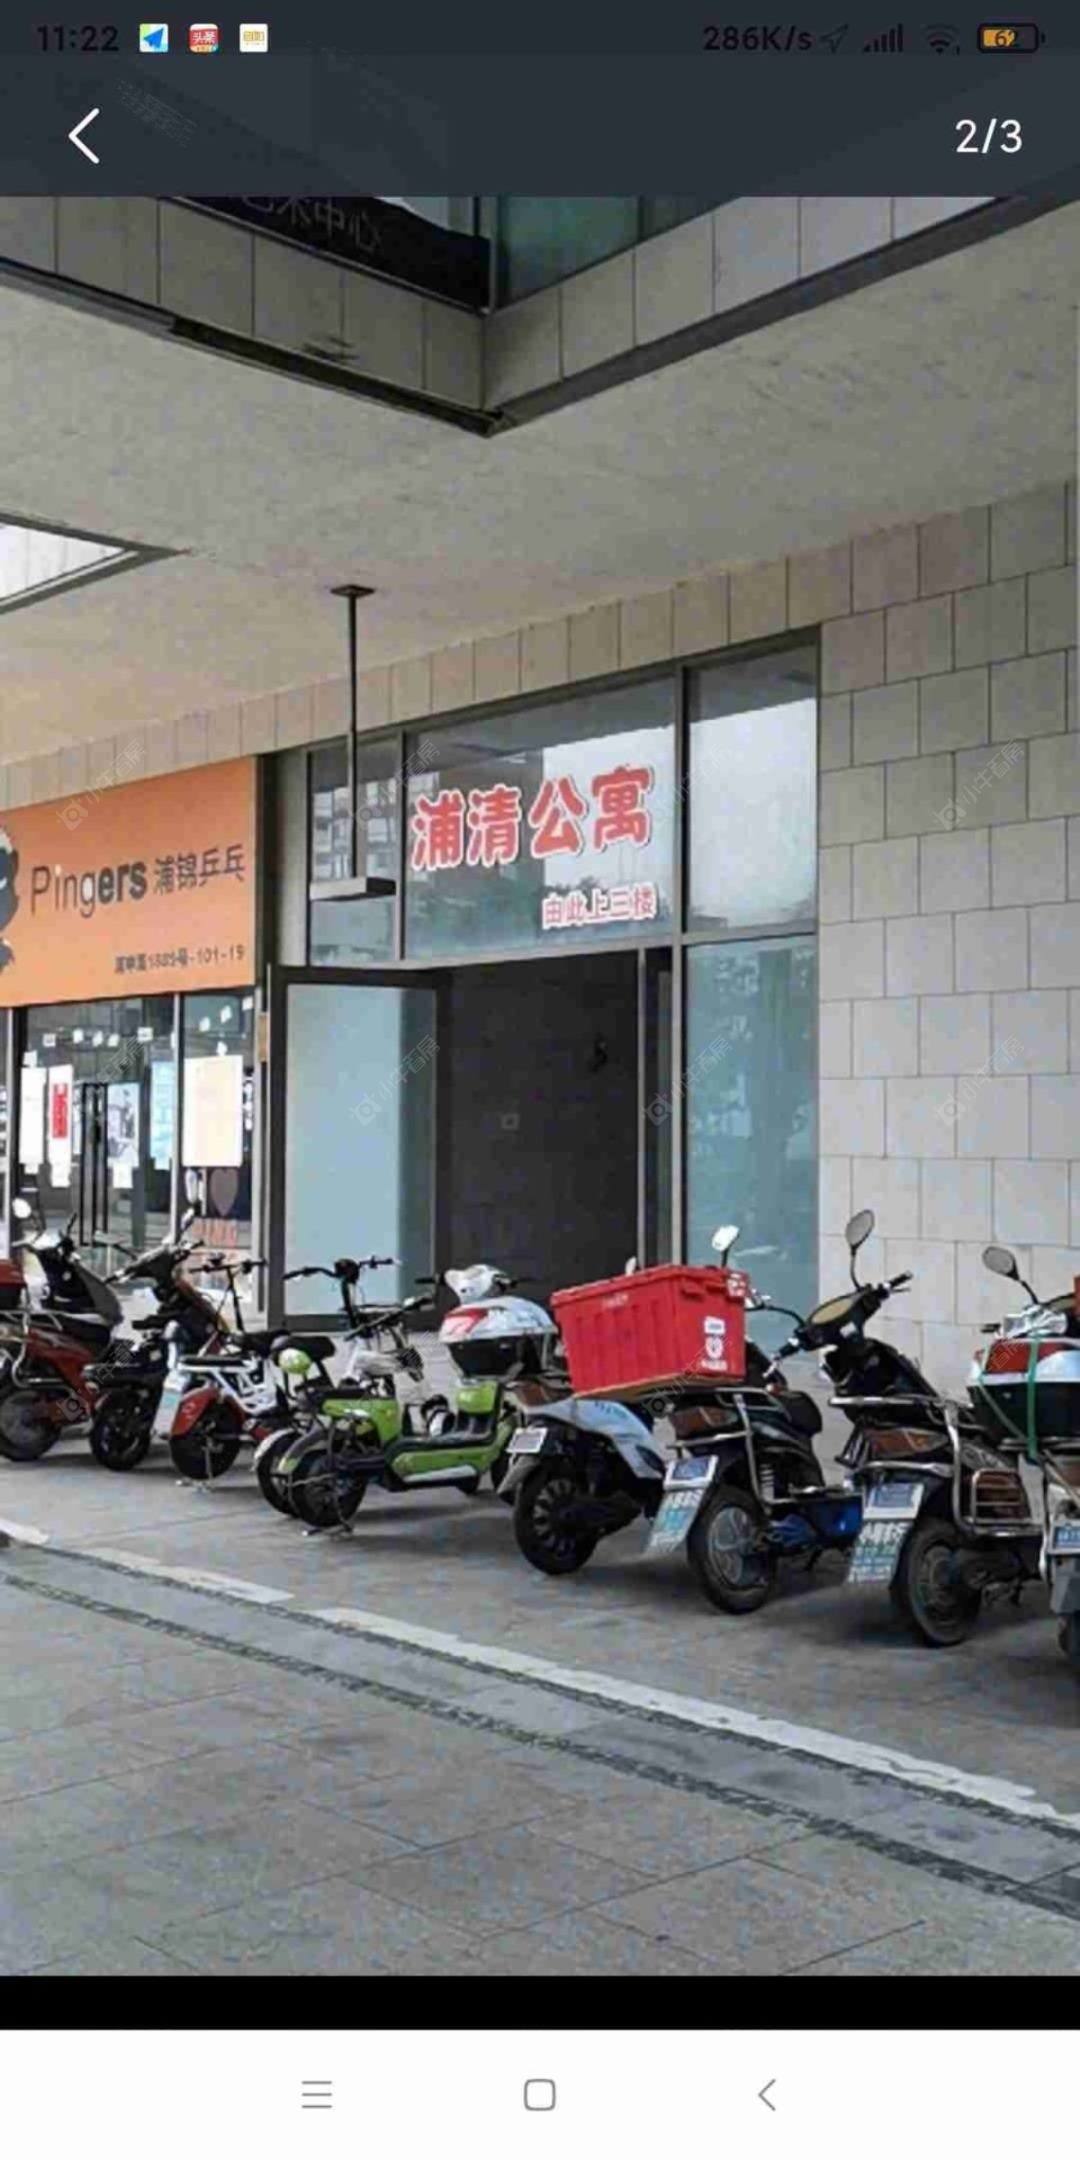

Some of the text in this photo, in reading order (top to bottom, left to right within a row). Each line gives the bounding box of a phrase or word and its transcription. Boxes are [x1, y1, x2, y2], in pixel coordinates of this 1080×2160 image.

[36, 25, 119, 51] 11:22
[703, 25, 812, 51] 286K/s
[954, 118, 1024, 154] 2/3
[409, 763, 655, 873] 浦清公寓
[30, 843, 246, 920] Pingers 浦锦乒乓
[541, 882, 658, 930] 由此上三楼
